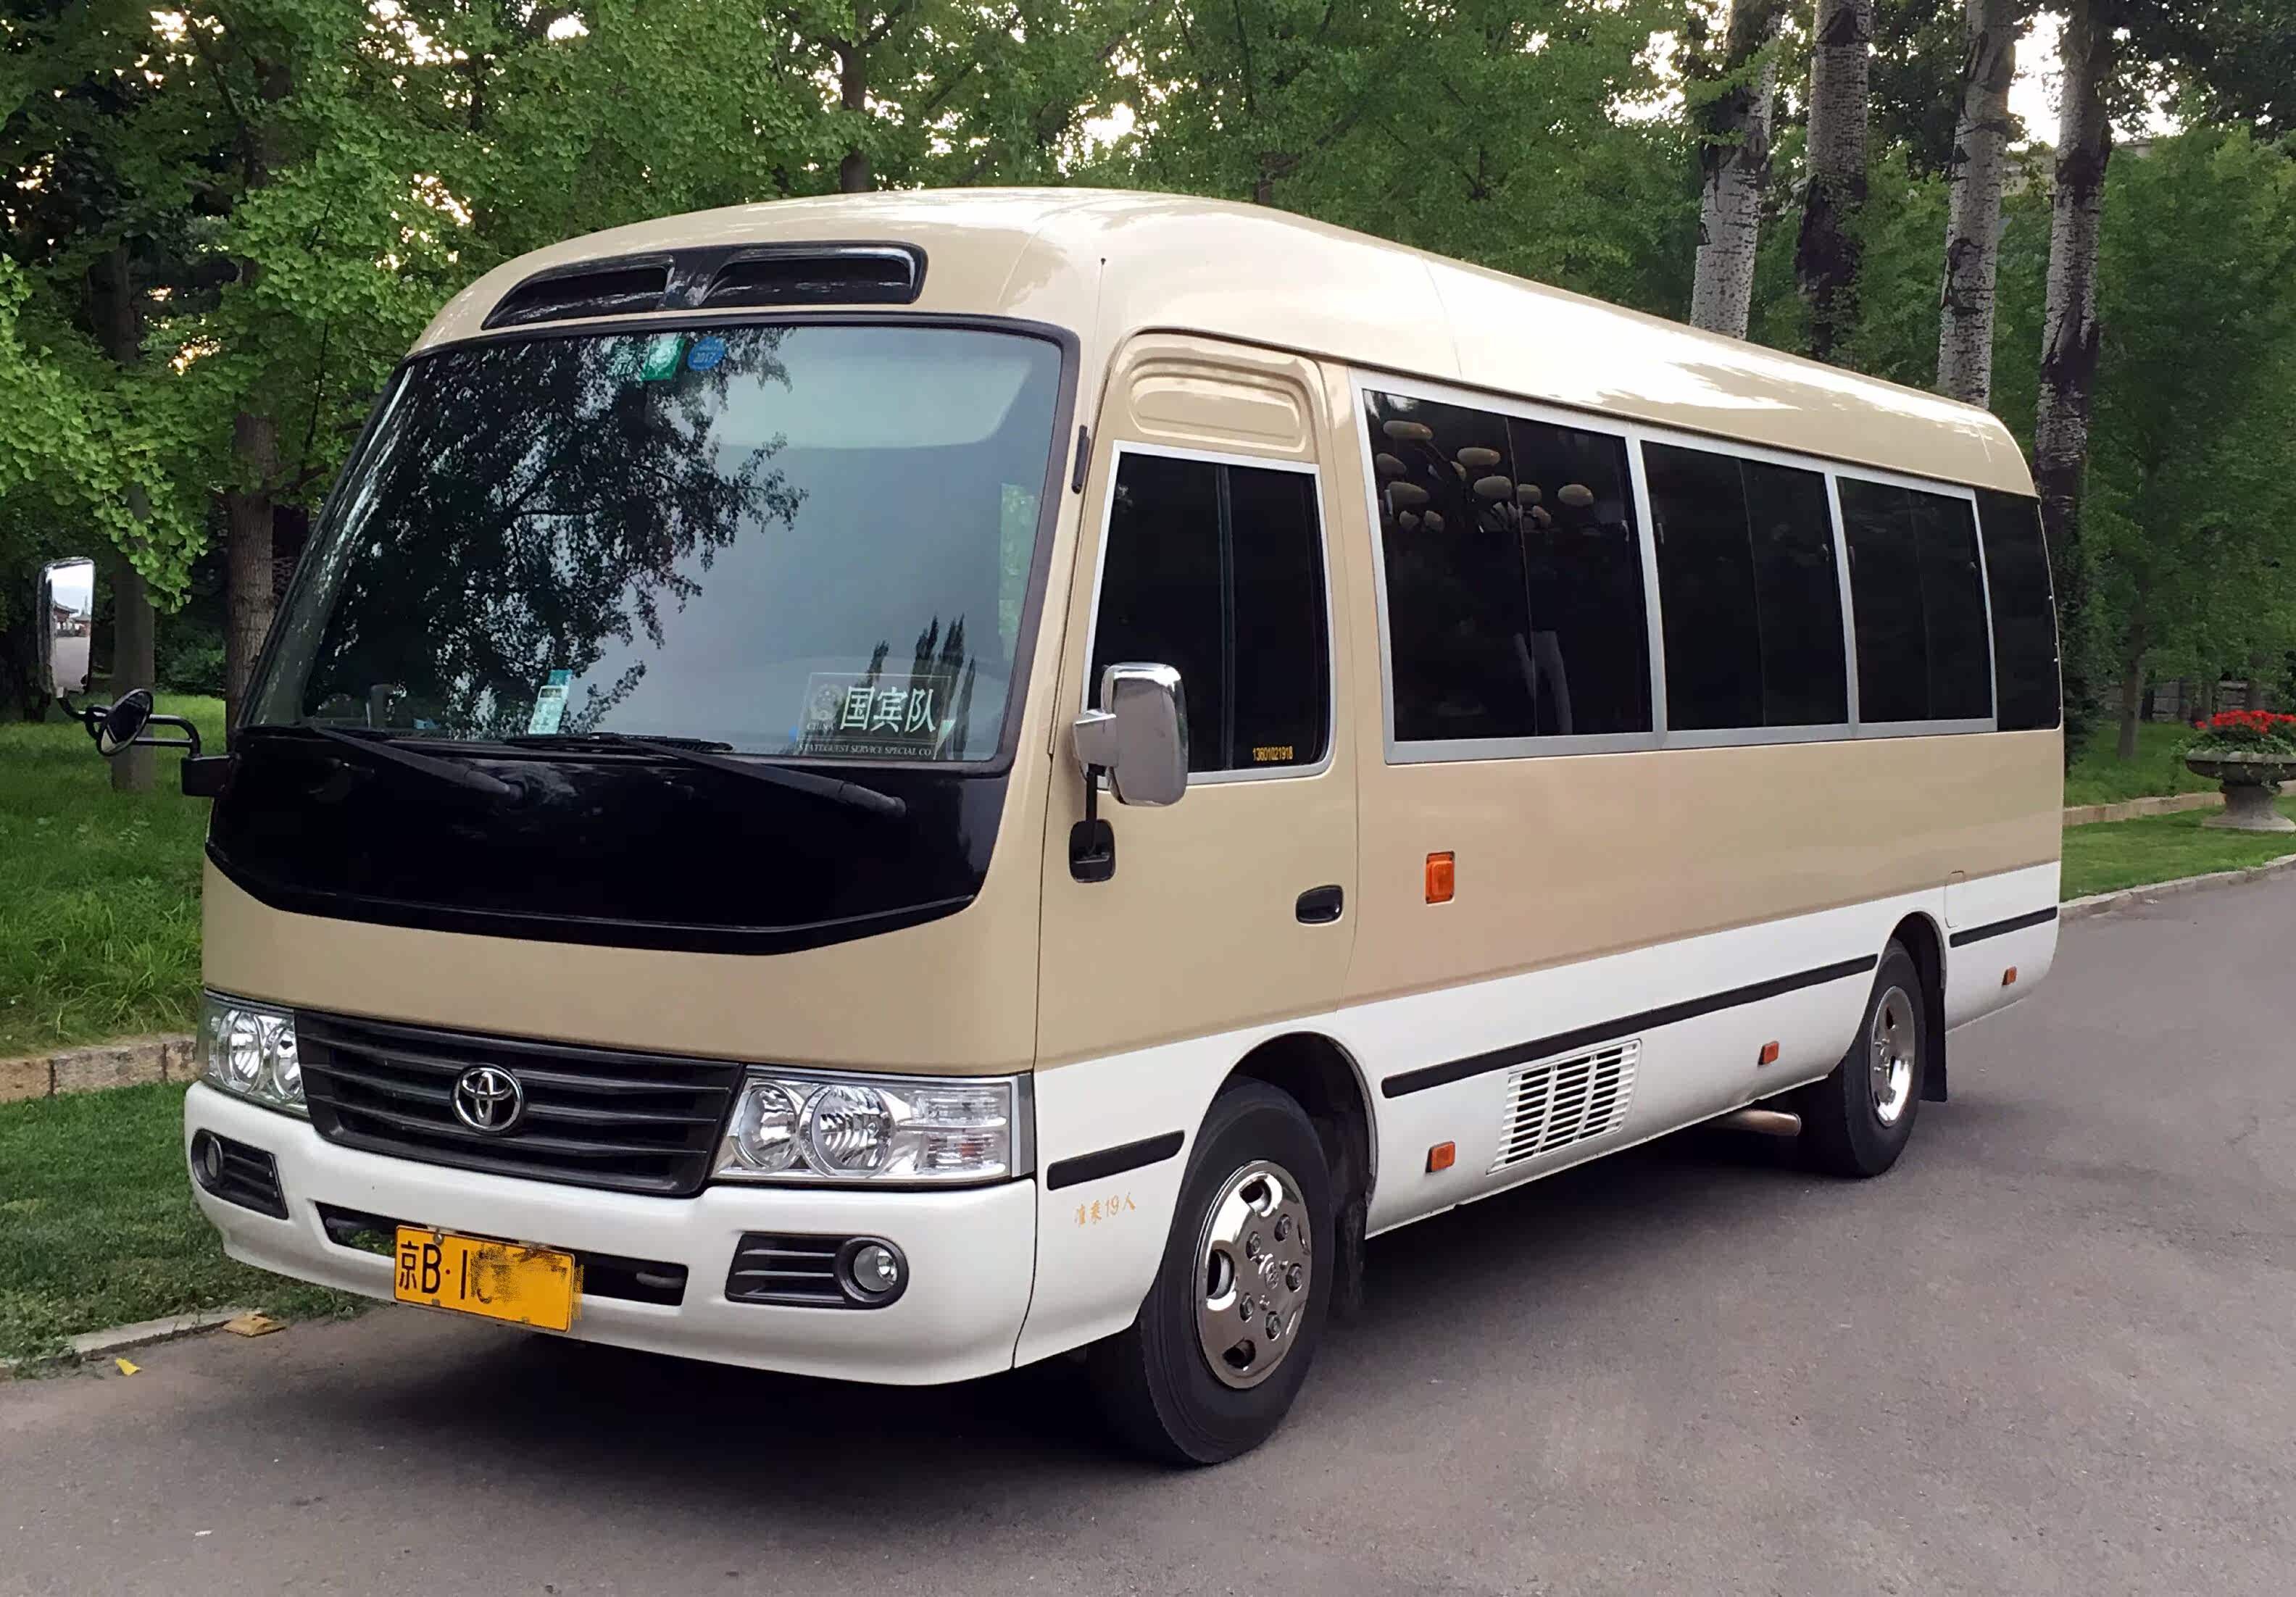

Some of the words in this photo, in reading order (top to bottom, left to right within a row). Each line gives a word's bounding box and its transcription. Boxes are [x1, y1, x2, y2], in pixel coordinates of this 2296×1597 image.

[839, 686, 936, 733] 国宾队
[850, 744, 883, 754] SERVICE
[884, 746, 918, 756] SPECIAL
